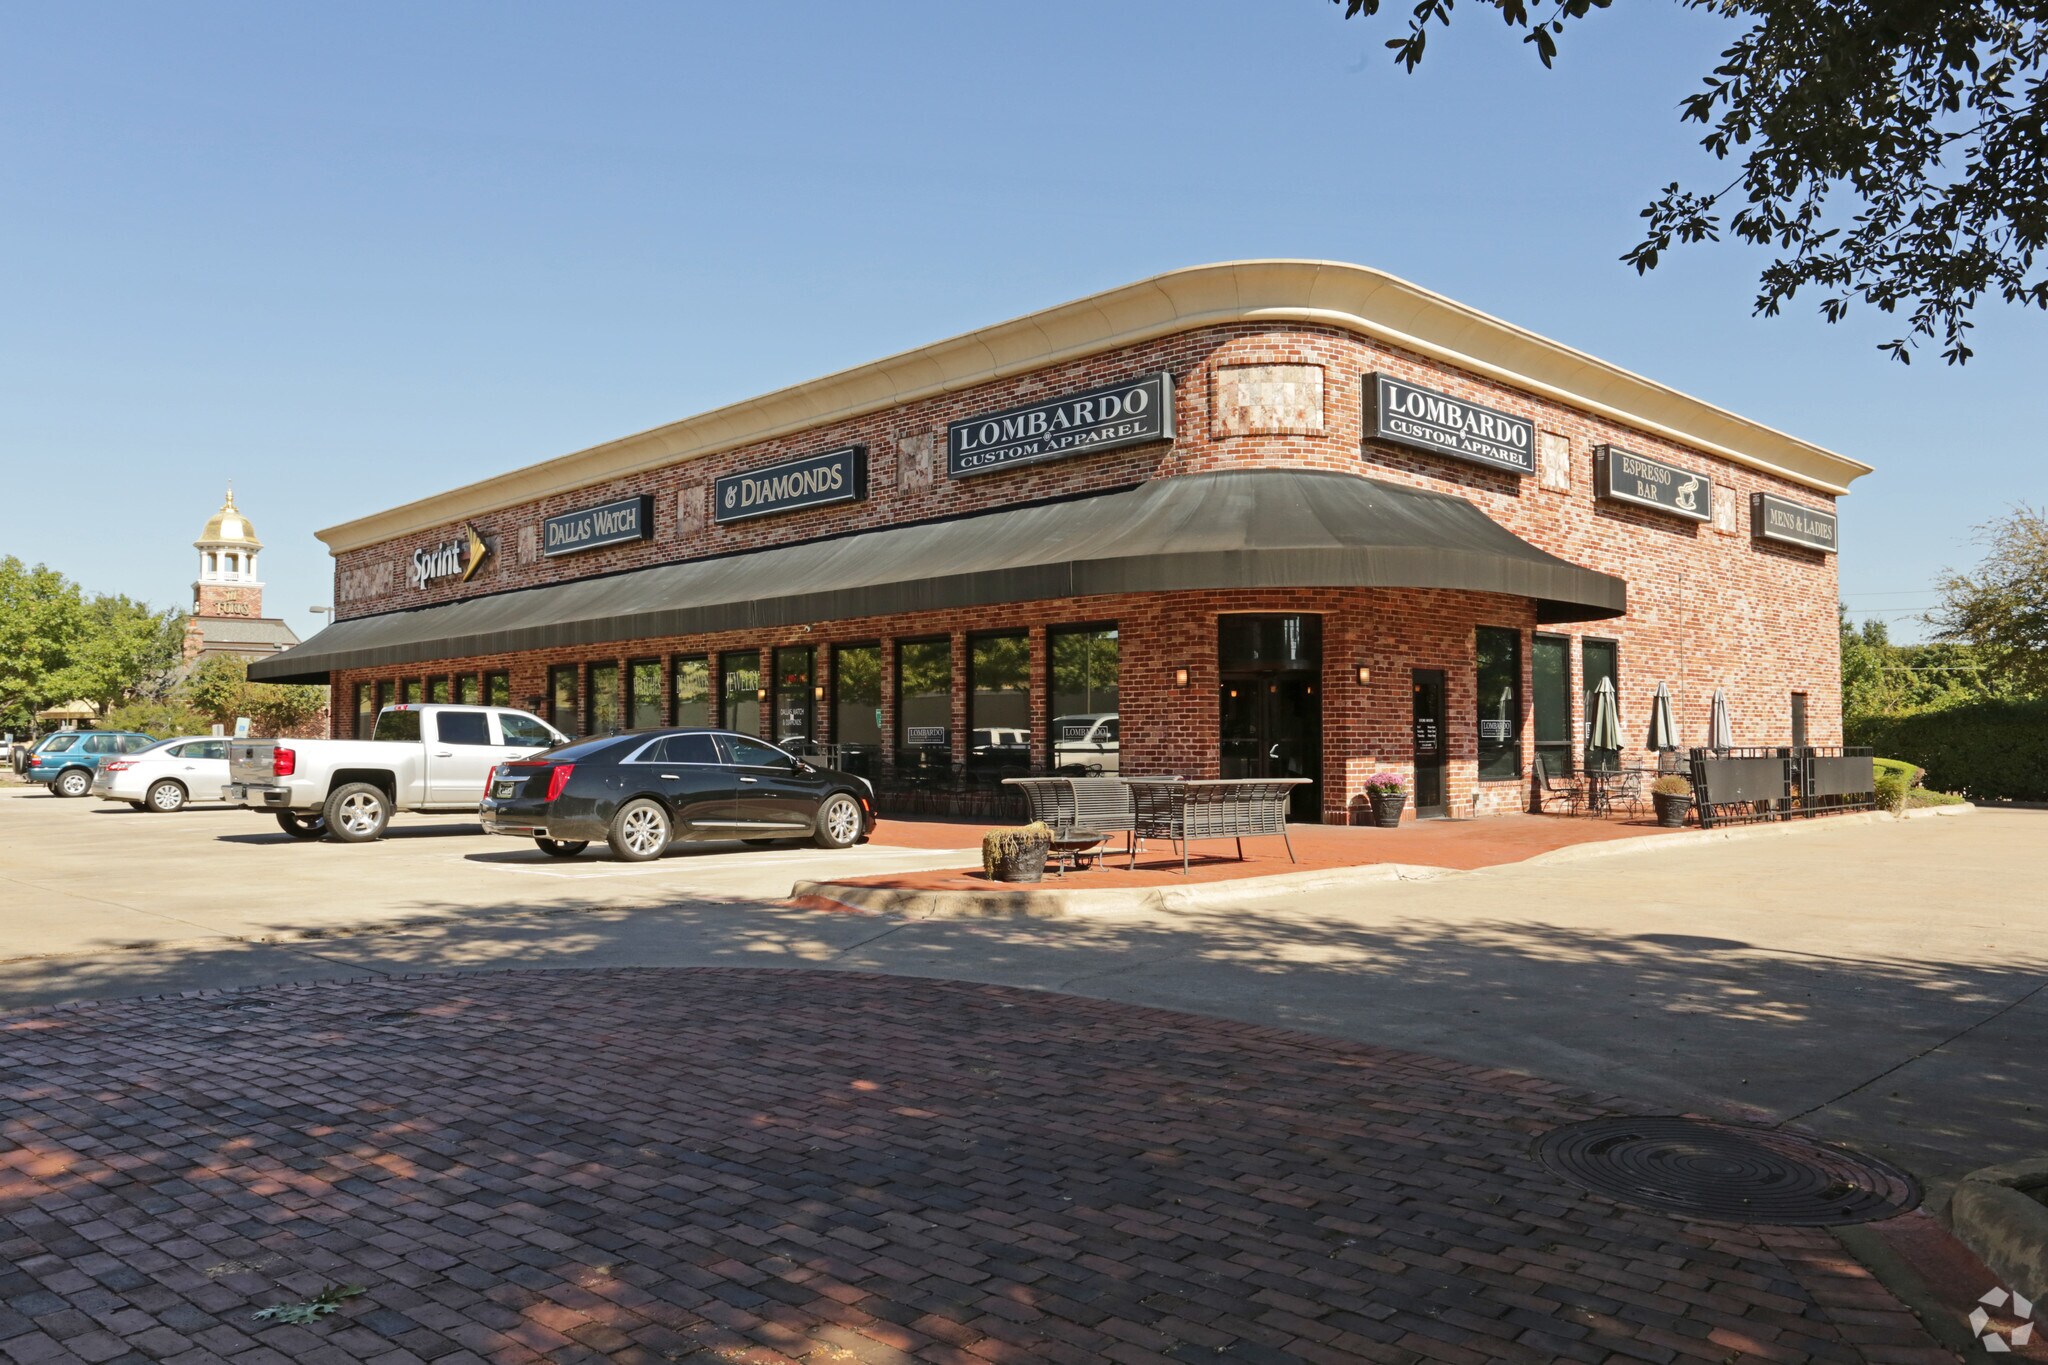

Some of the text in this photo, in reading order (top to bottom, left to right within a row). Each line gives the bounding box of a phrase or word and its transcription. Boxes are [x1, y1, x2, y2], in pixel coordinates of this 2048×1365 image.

[959, 388, 1149, 450] LOMBARDO
[1389, 385, 1527, 448] LOMBARDO
[960, 421, 1148, 468] CUSTOM APPAREL
[1389, 419, 1528, 466] CUSTOM APPAREL
[724, 463, 843, 509] & DIAMONDS
[1622, 456, 1671, 486] ESPRESSO
[1636, 480, 1658, 501] BAR
[549, 507, 637, 547] DALLAS WATCH
[1770, 508, 1833, 540] MENS & LADIES
[413, 540, 462, 590] Sprint
